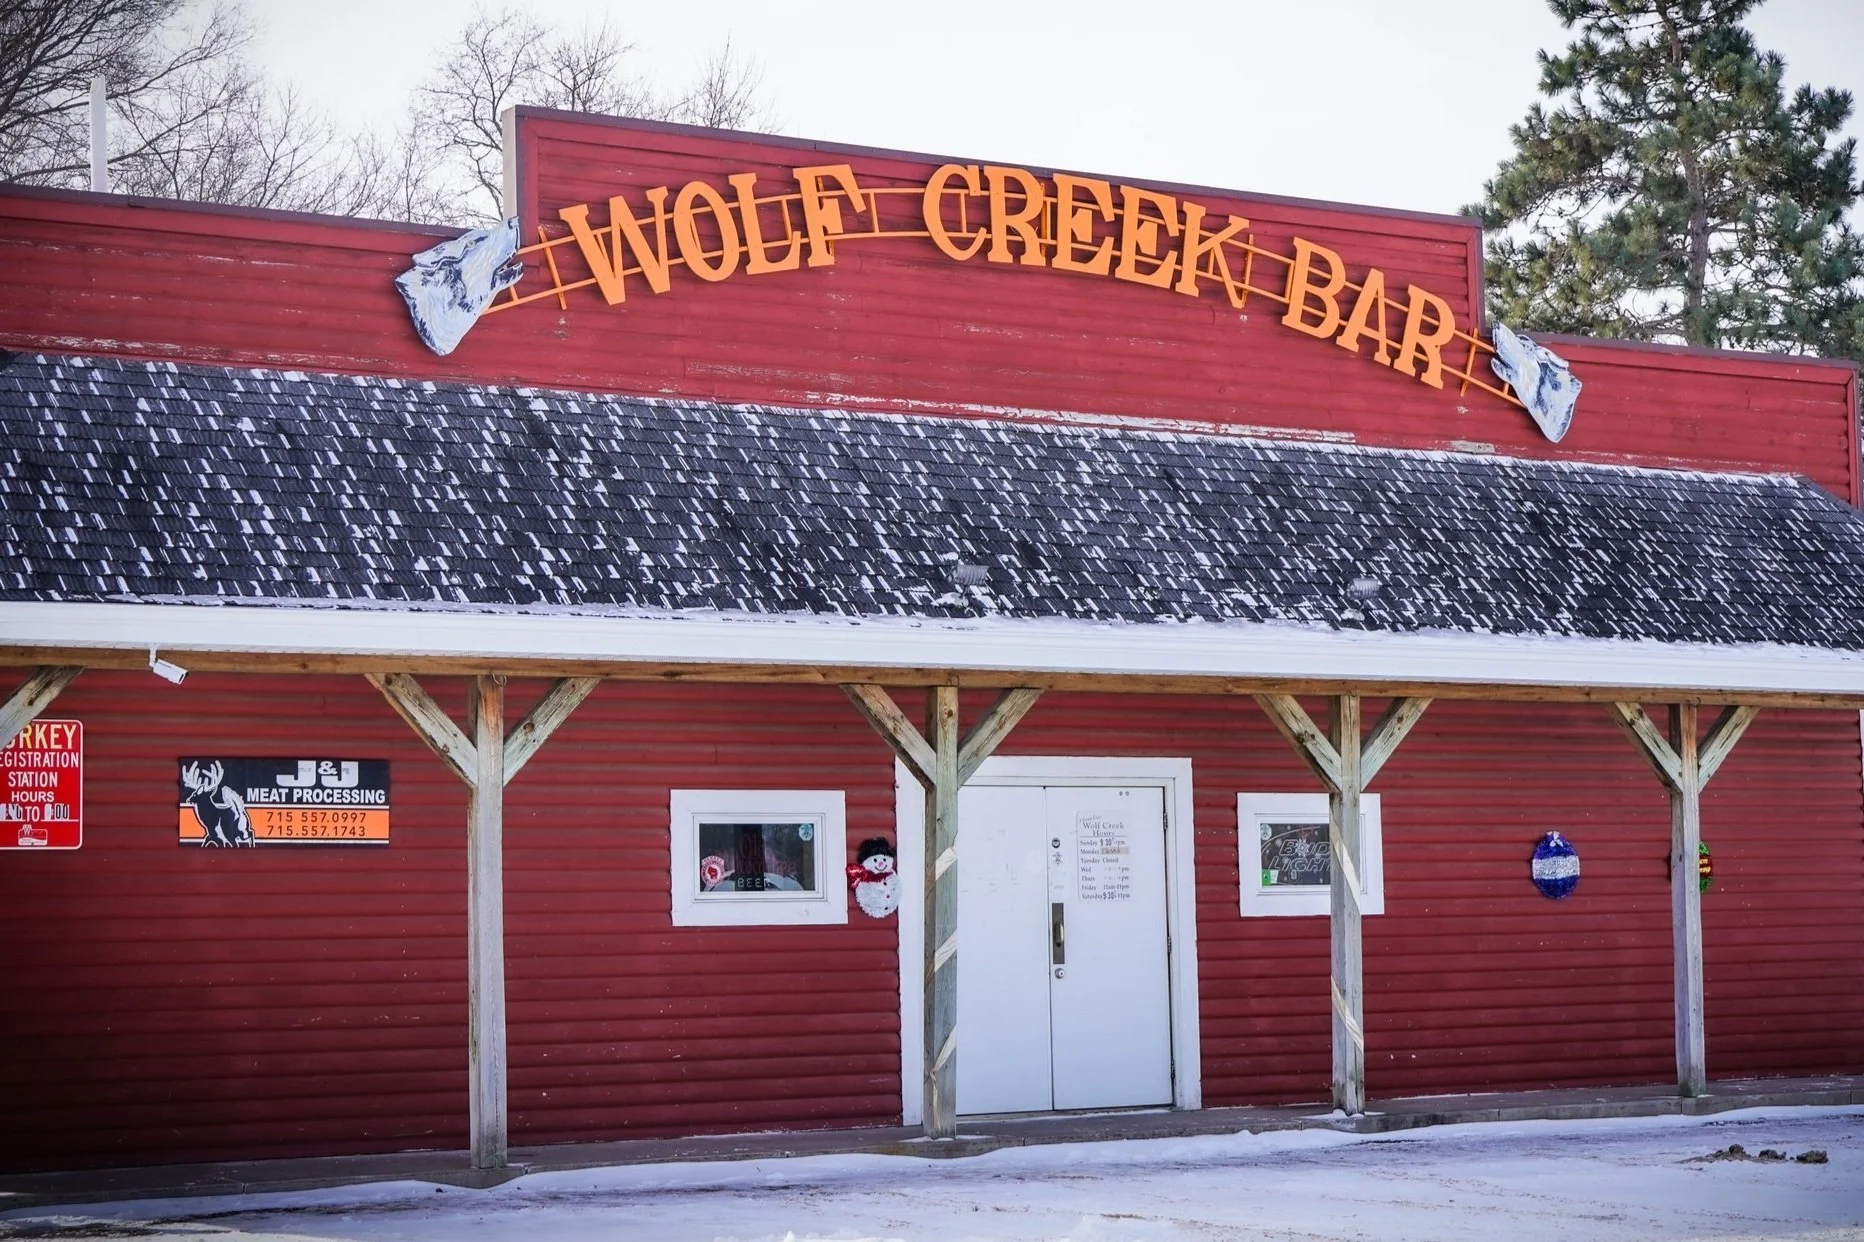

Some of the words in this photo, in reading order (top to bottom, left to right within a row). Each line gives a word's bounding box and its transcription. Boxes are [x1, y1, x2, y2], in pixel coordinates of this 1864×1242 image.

[559, 164, 866, 306] WOLF
[922, 164, 1250, 309] CREEK
[1281, 238, 1457, 390] BAR
[5, 723, 77, 749] RKEY
[8, 771, 58, 788] STATION
[276, 760, 359, 788] J&J
[11, 791, 55, 802] HOURS
[246, 787, 289, 803] MEAT
[293, 788, 386, 805] PROCESSING
[25, 806, 40, 822] TO
[266, 811, 293, 823] 715
[301, 811, 367, 824] 557.0997
[266, 825, 366, 837] 715.557.1743
[1102, 822, 1125, 830] Creek
